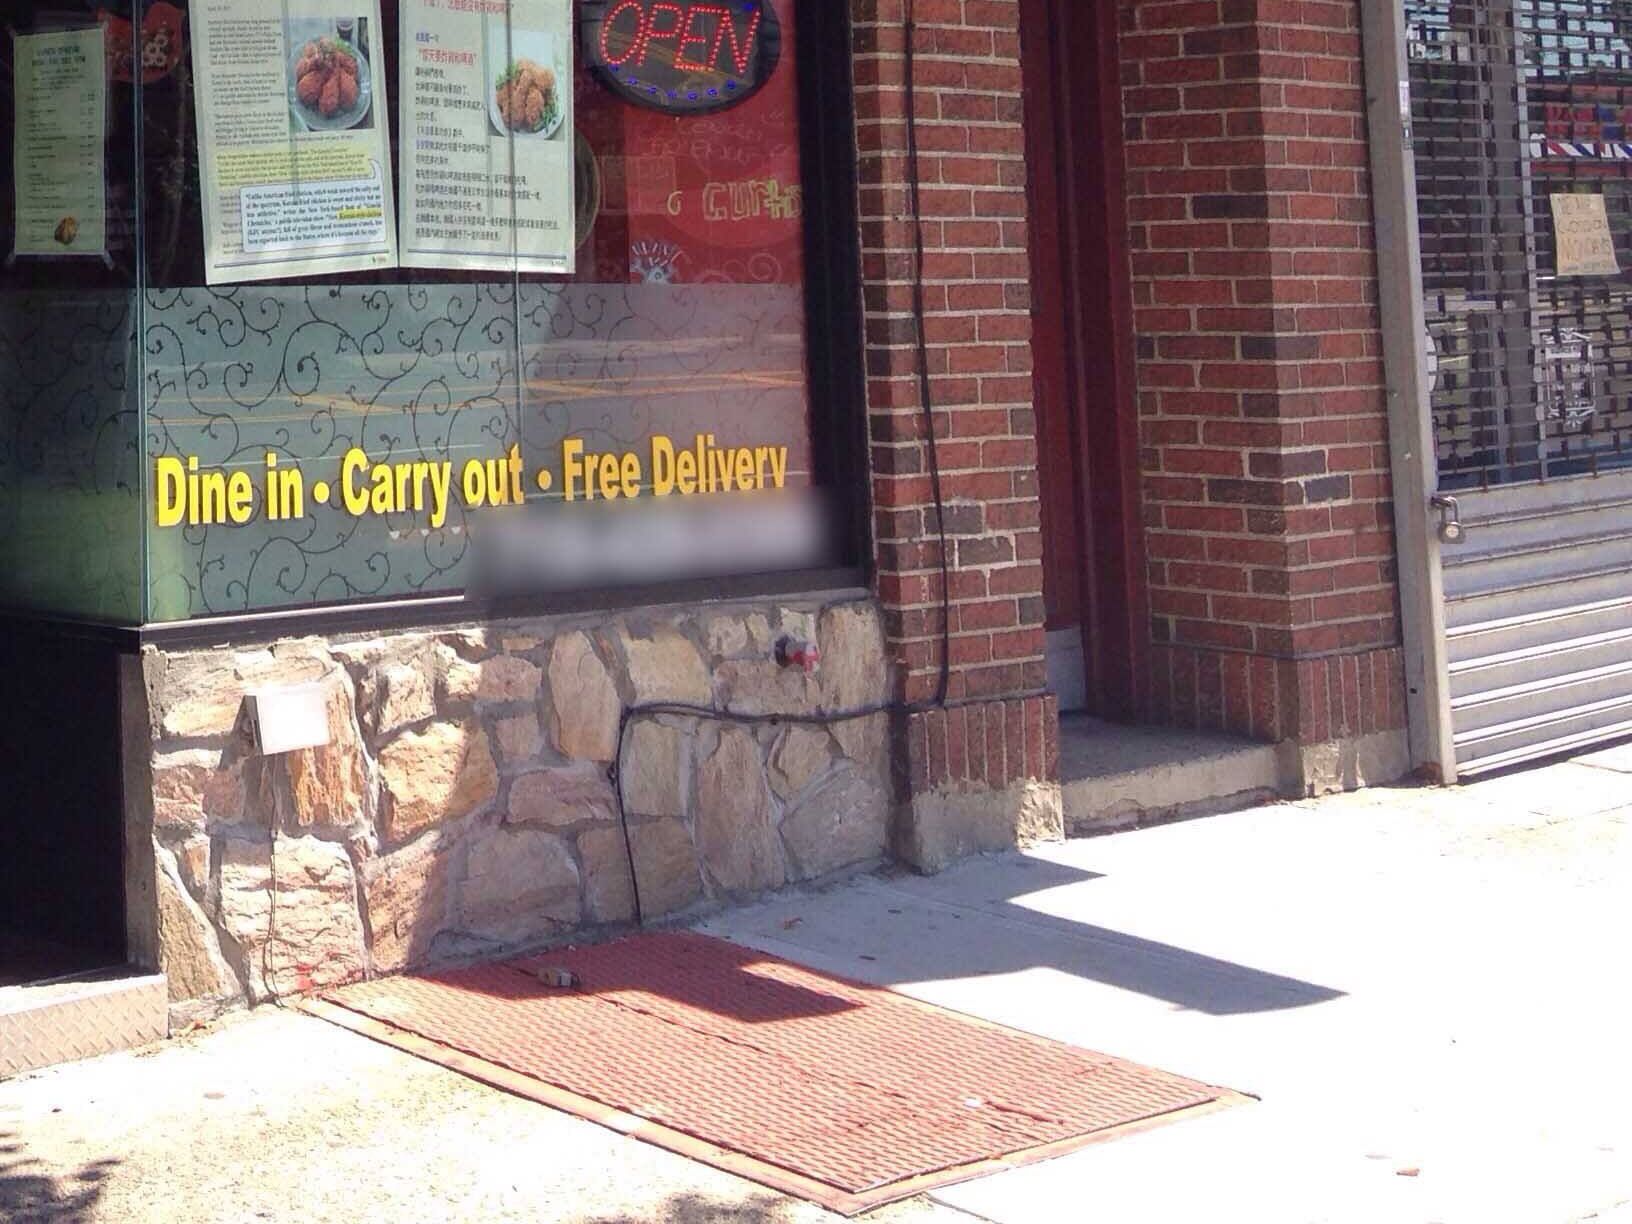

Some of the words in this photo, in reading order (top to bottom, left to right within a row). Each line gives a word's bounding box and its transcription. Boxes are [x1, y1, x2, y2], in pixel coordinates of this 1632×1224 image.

[156, 456, 253, 527] Dine
[266, 452, 304, 521] in
[341, 447, 452, 528] Carry
[463, 443, 524, 506] out
[562, 437, 641, 501] Free
[651, 433, 789, 498] Delivery
